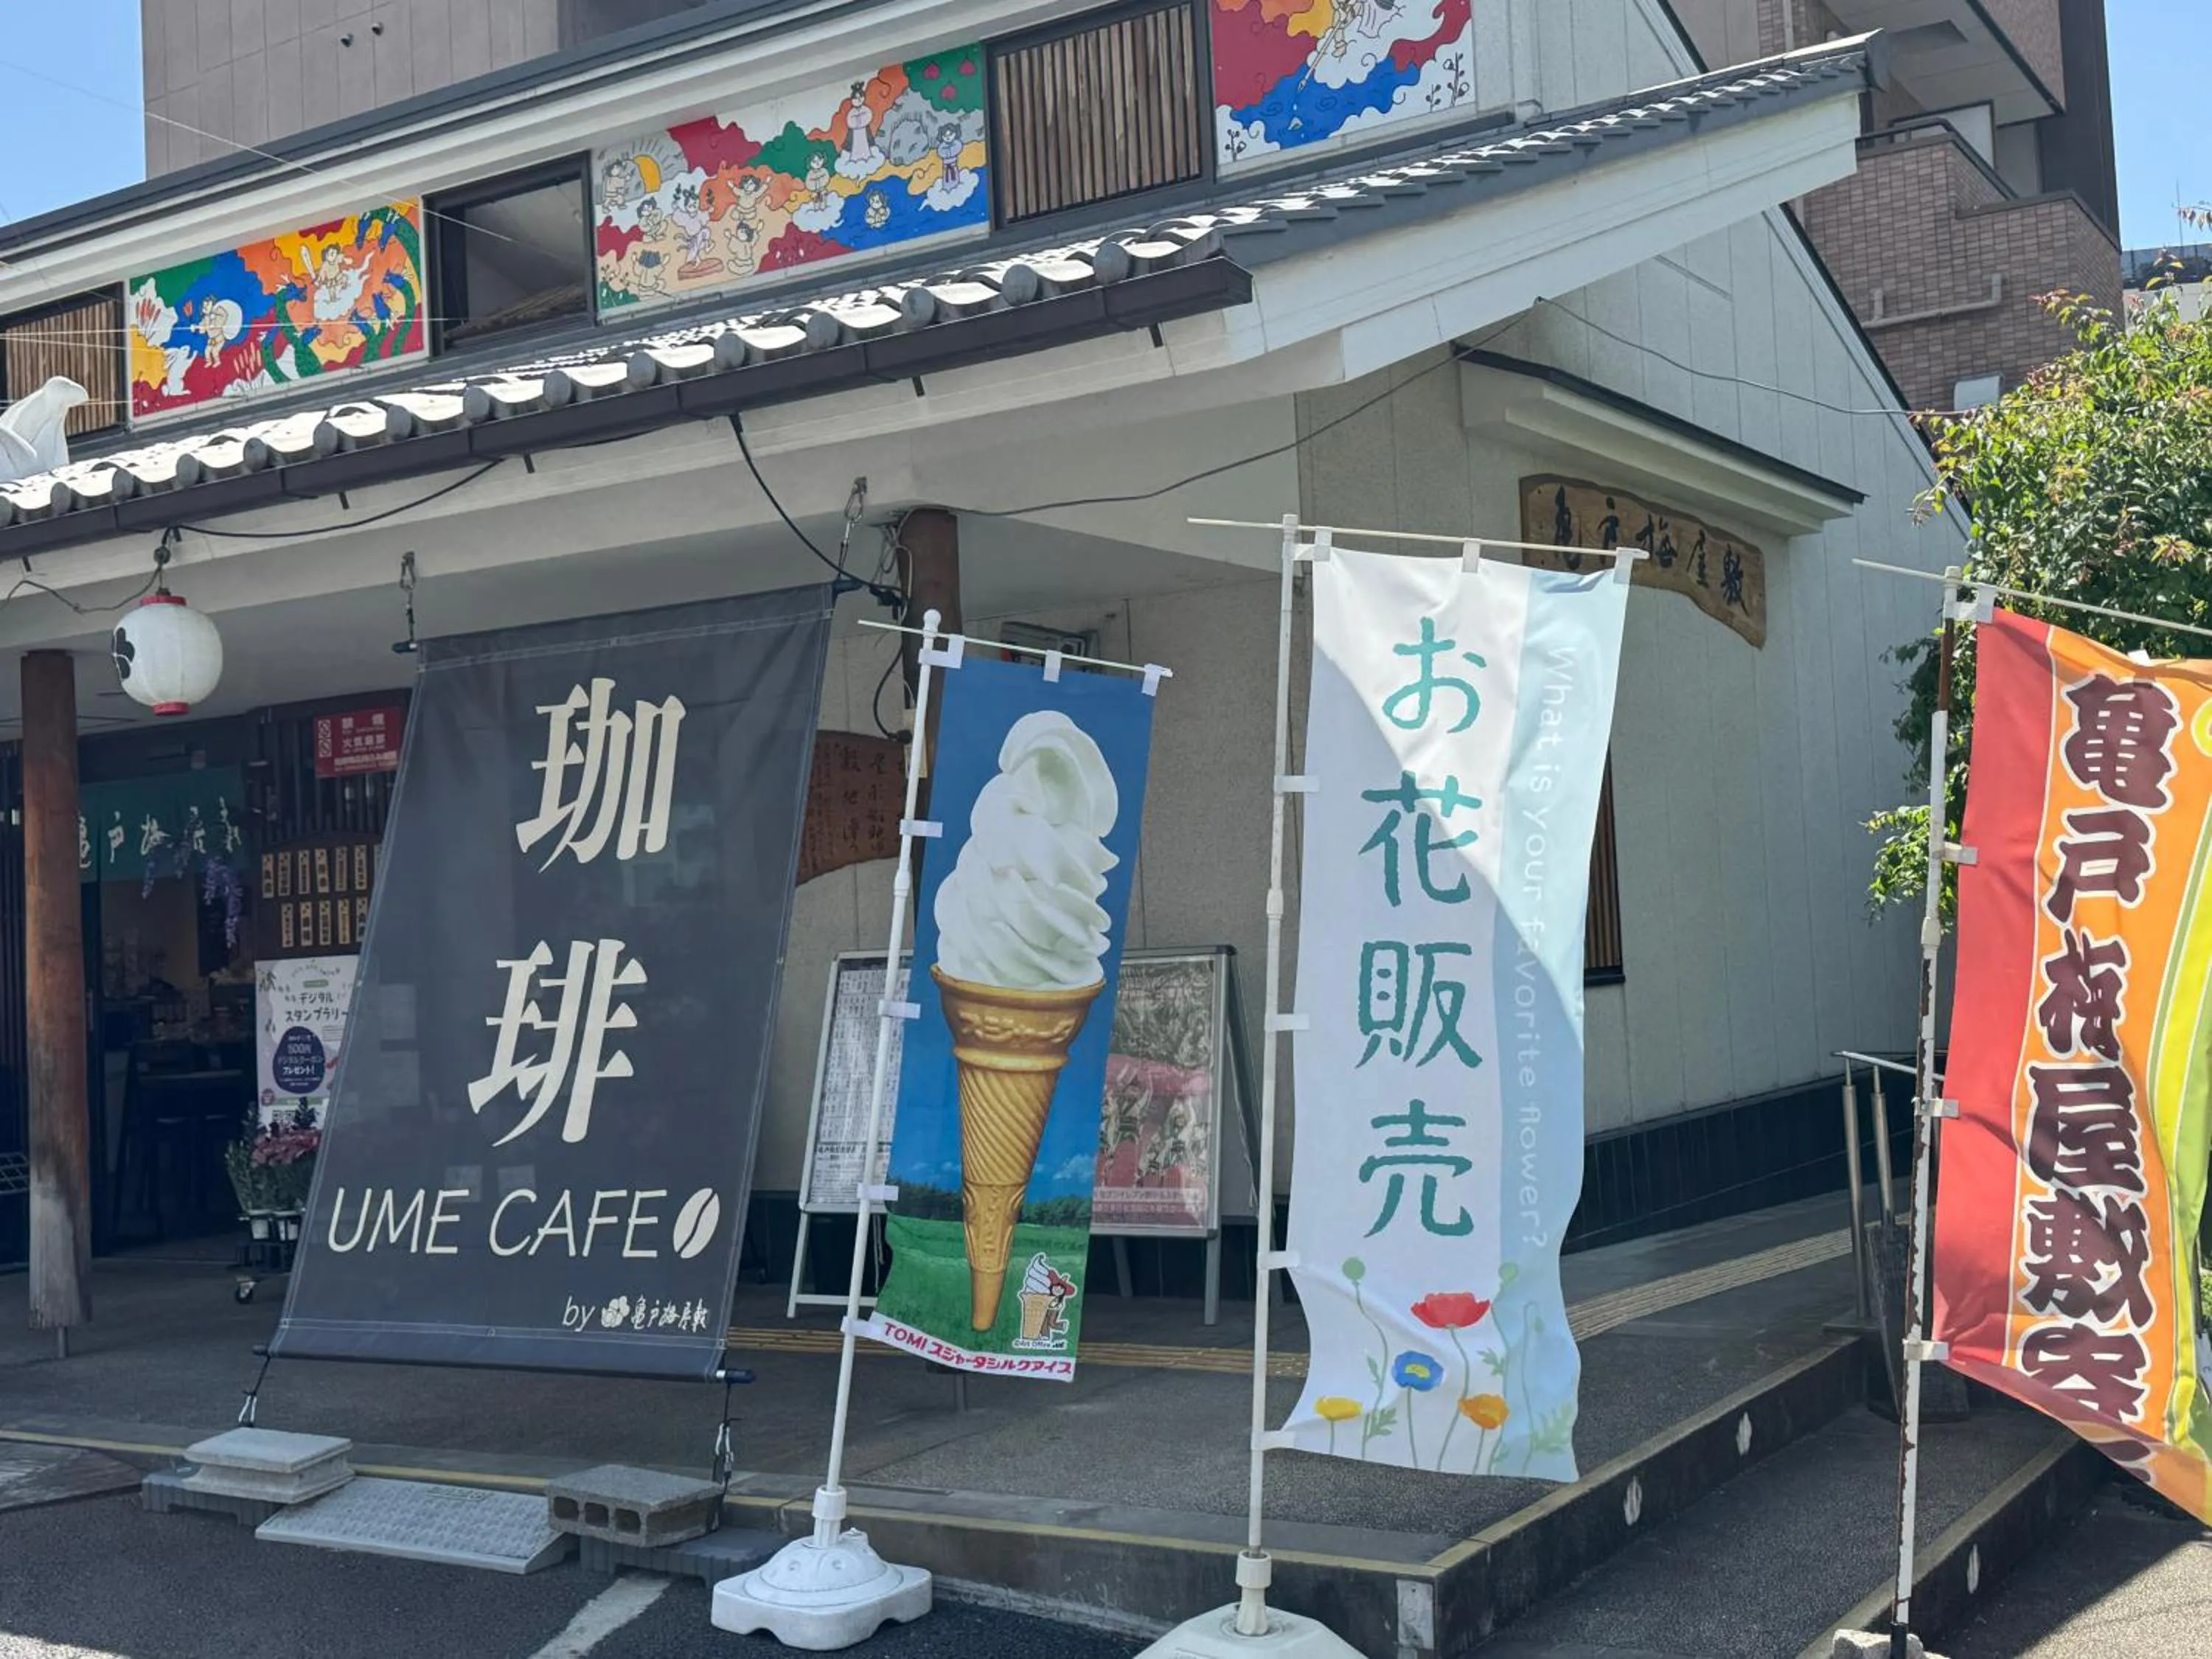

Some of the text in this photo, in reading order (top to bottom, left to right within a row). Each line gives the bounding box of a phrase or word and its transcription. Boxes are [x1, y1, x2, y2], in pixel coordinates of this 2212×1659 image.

[467, 678, 686, 1147] 珈琲
[1354, 617, 1486, 1239] お花販売
[1514, 646, 1579, 1248] What is your favorite flower?
[285, 1007, 348, 1022] スタンプラリー
[299, 992, 333, 1004] デジタル
[328, 1188, 667, 1258] UME CAFE
[562, 1295, 596, 1332] by
[885, 1322, 1071, 1374] TOMI スジャータシルクアイス
